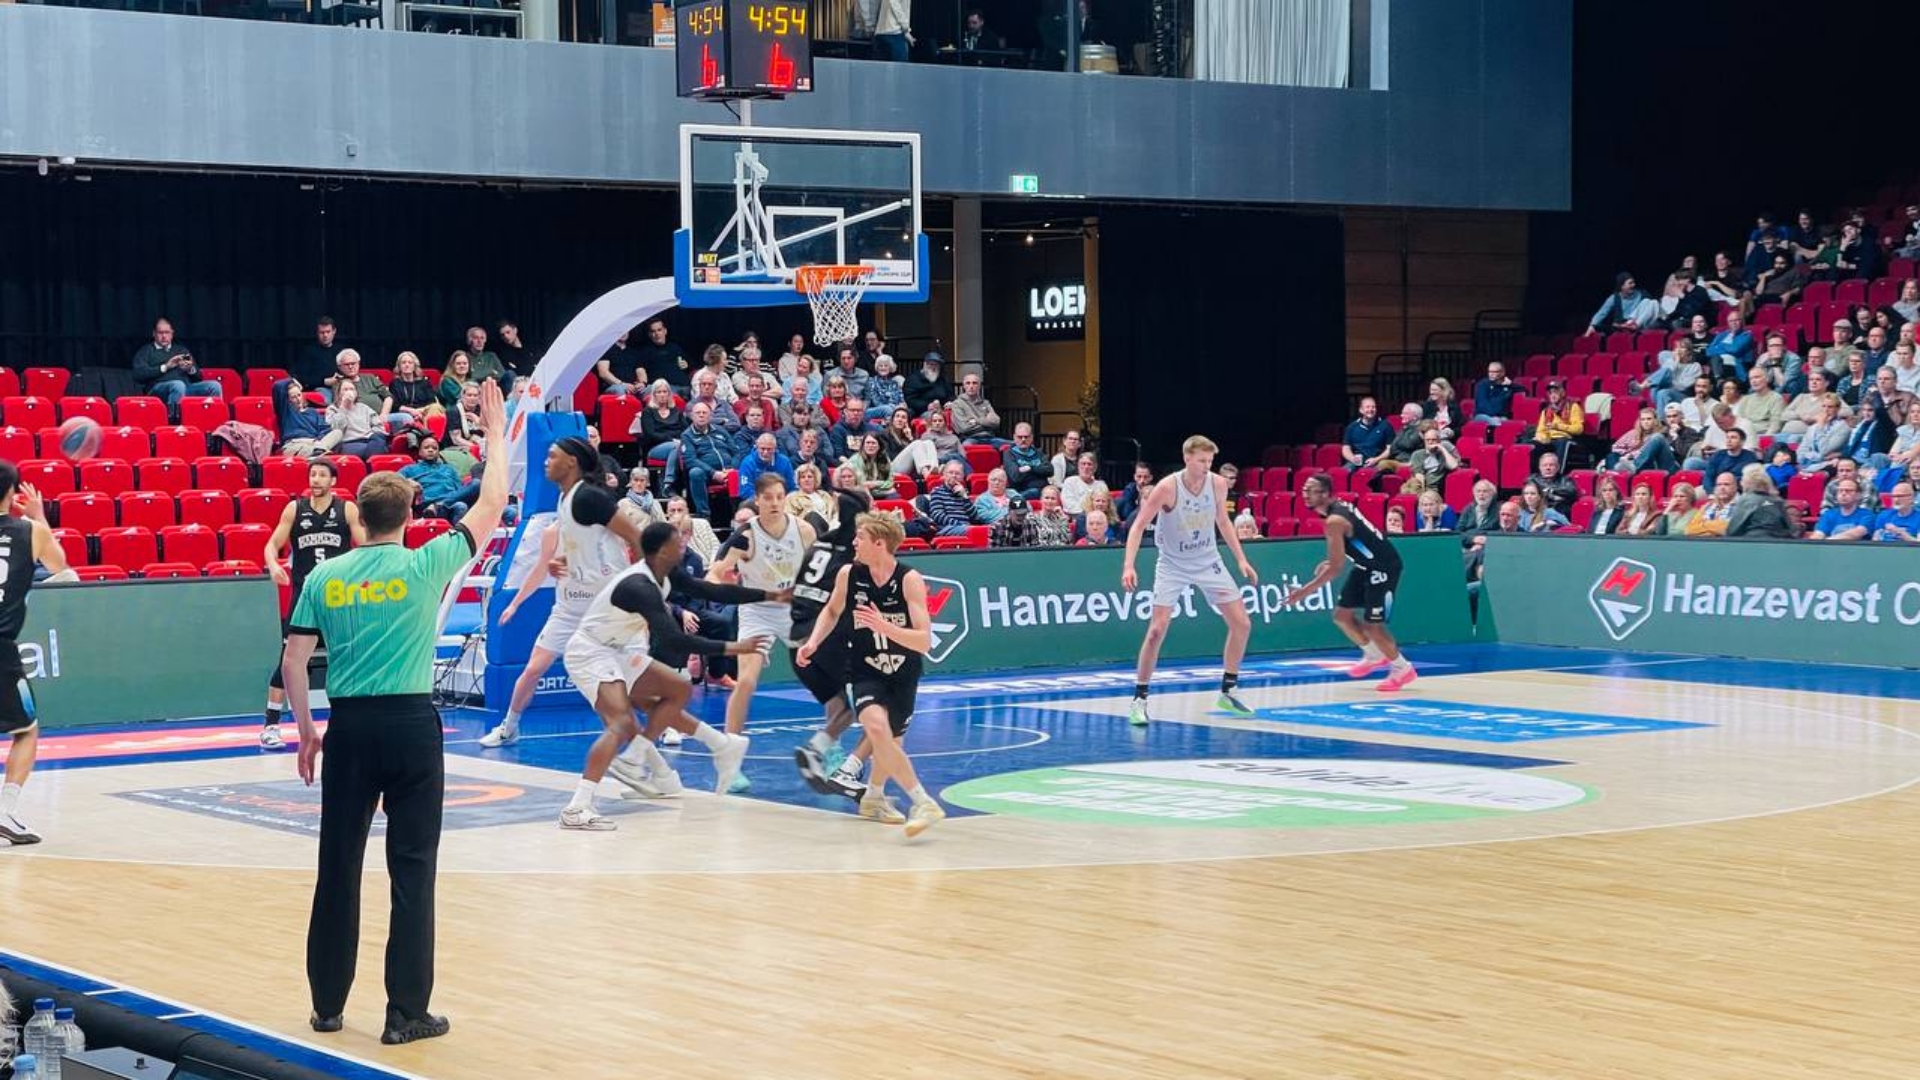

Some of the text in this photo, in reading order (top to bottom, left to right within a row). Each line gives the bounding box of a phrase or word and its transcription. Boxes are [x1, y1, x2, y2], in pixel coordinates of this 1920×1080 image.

[688, 5, 723, 36] 4:54
[749, 4, 806, 36] 4:54
[804, 549, 833, 584] 9
[325, 578, 408, 609] Brico
[1209, 573, 1335, 624] apital
[1663, 573, 1882, 624] Hanzevast
